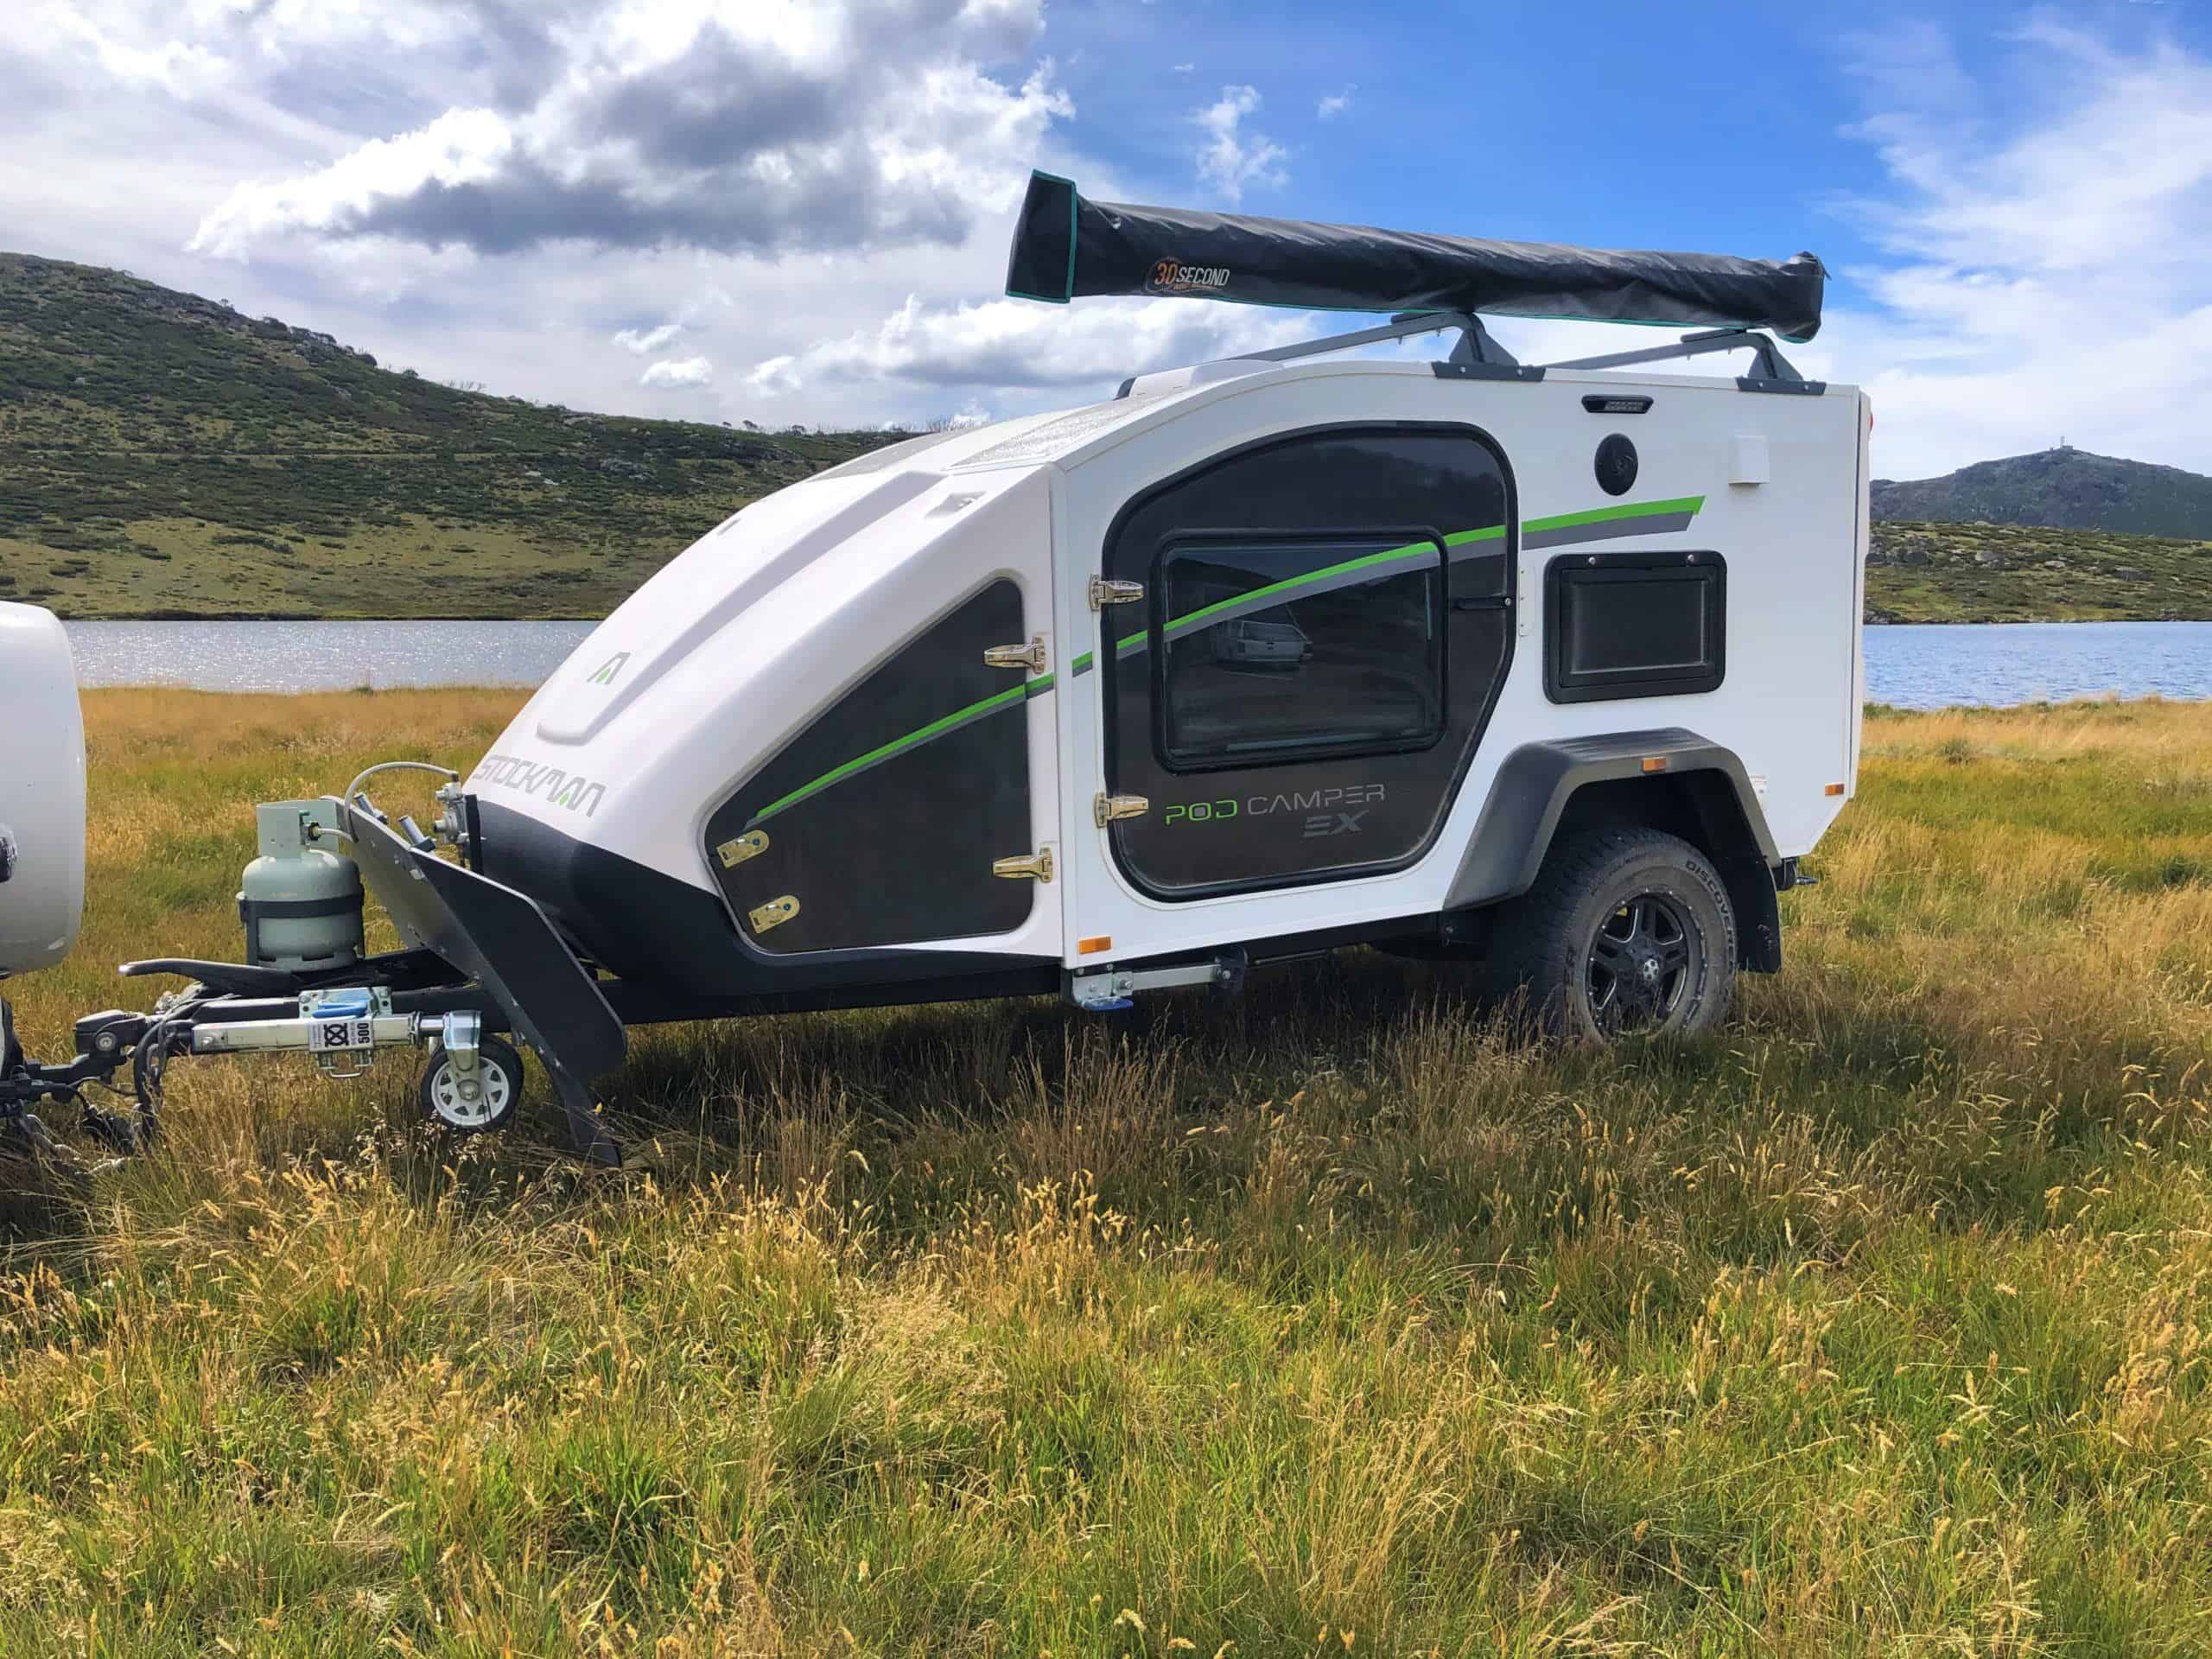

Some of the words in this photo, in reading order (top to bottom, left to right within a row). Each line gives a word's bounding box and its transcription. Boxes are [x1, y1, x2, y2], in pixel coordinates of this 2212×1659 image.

[1154, 262, 1179, 285] 30
[1175, 266, 1230, 286] SECOND
[473, 754, 607, 817] STOCKMAN
[1166, 799, 1238, 825] POD
[1247, 784, 1385, 815] CAMPER
[1302, 809, 1370, 837] EX
[357, 1022, 371, 1045] 500
